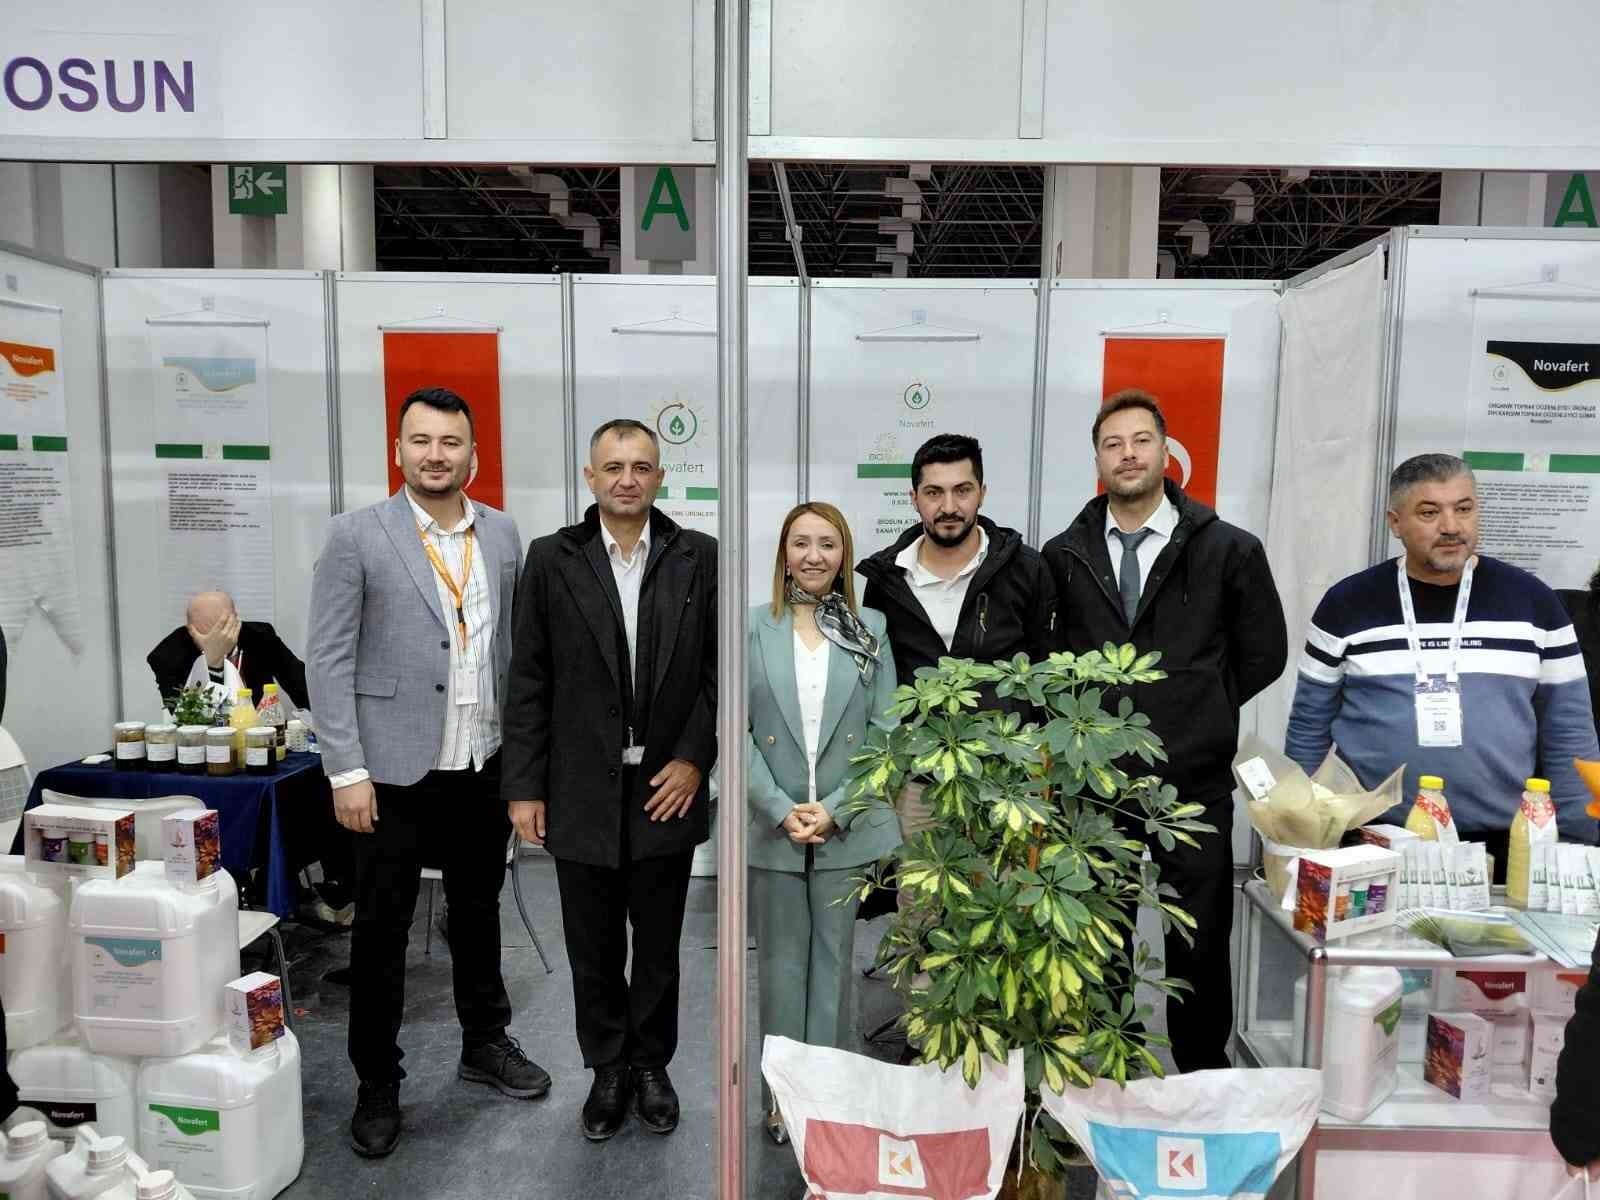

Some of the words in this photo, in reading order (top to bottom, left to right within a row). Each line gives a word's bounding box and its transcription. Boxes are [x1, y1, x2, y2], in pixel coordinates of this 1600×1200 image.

[4, 56, 194, 112] OSUN
[641, 165, 690, 231] A
[1553, 173, 1599, 228] A
[1533, 359, 1590, 372] Novafert
